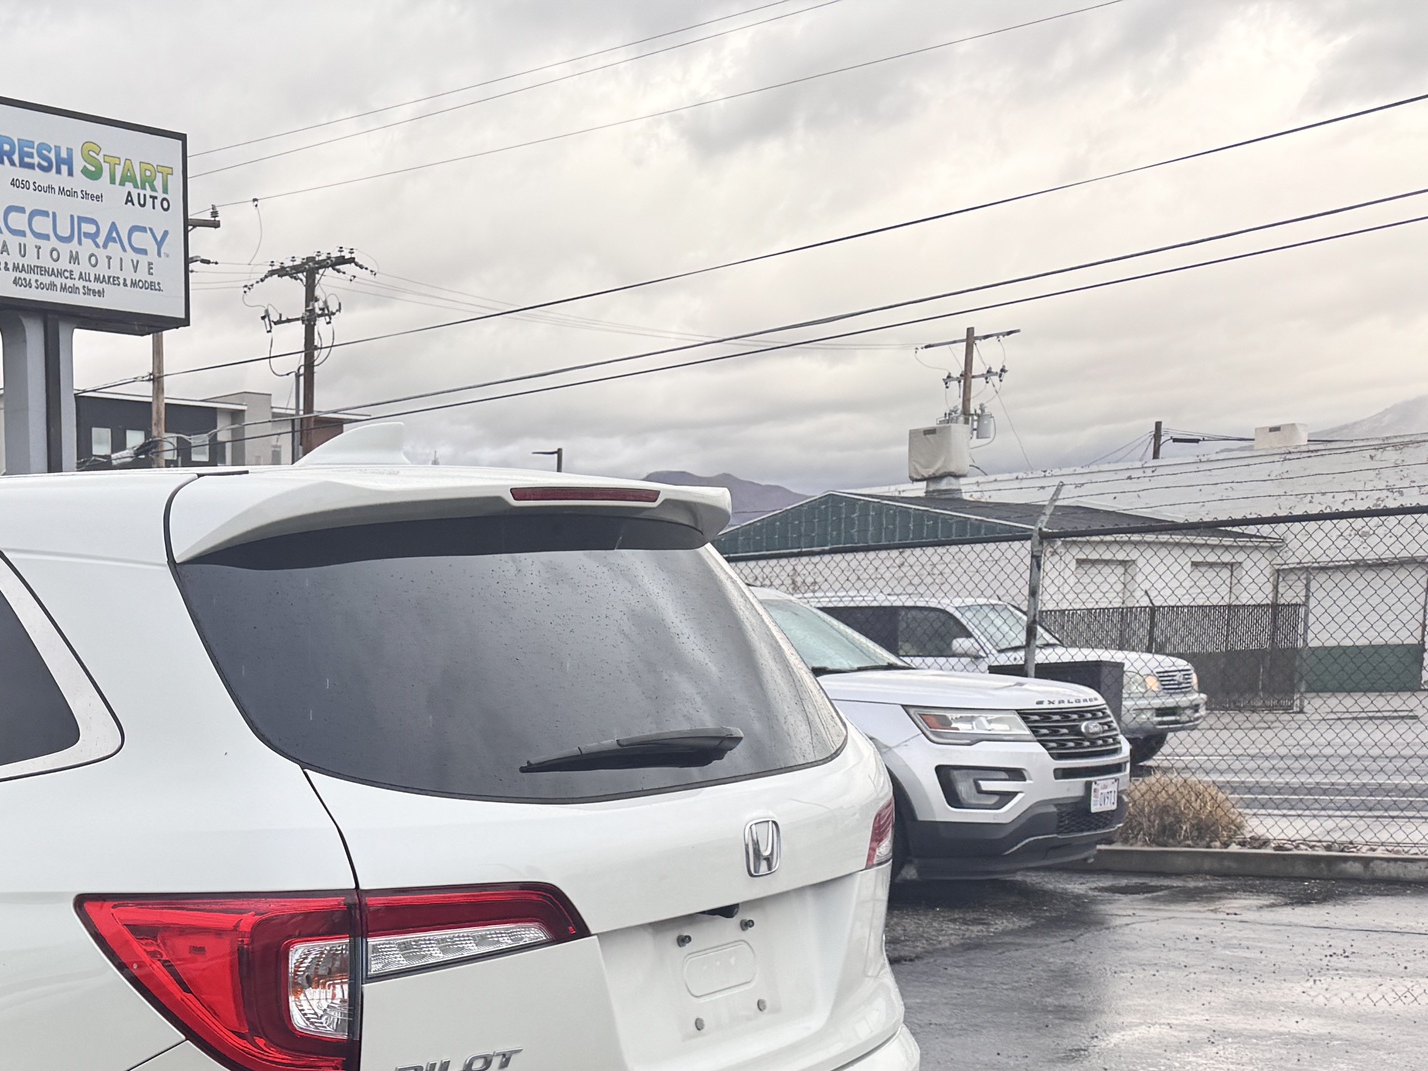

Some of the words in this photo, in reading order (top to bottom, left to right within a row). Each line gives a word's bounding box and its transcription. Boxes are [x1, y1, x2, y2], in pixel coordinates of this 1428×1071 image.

[80, 141, 173, 195] START
[10, 178, 30, 190] 4050
[32, 181, 56, 194] South
[58, 186, 78, 199] Main
[80, 190, 103, 203] Street
[124, 191, 171, 212] AUTO
[0, 240, 154, 276] AUTOMOTIVE
[3, 261, 10, 272] &
[12, 262, 76, 281] MAINTENANCE.
[78, 271, 92, 283] ALL
[94, 273, 121, 287] MAKES
[122, 277, 128, 288] &
[130, 278, 164, 292] MODELS.
[12, 276, 32, 289] 4036
[34, 279, 58, 294] South
[60, 282, 80, 295] Main
[82, 285, 105, 298] Street
